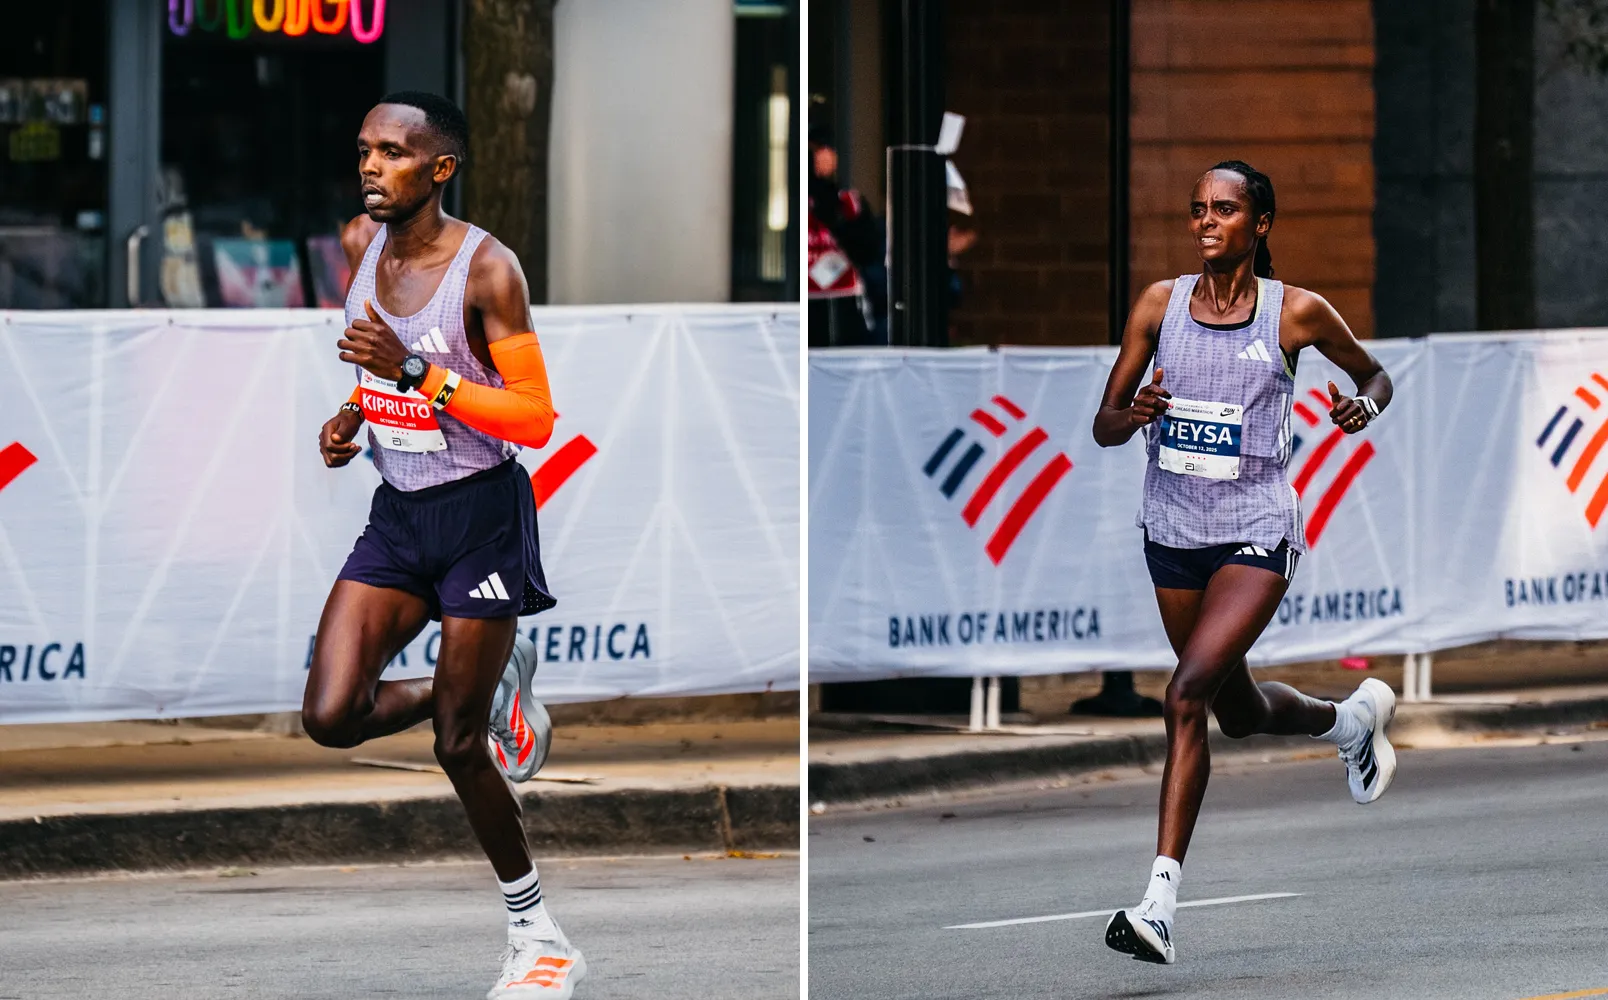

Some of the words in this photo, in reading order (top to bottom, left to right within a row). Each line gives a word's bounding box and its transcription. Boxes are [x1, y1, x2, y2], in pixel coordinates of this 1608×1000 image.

[362, 392, 431, 419] KIPRUTO
[379, 417, 399, 425] OCTOBER
[1177, 443, 1198, 451] OCTOBER
[1278, 595, 1303, 626] OF
[1310, 586, 1403, 624] AMERICA
[1505, 577, 1558, 608] BANK
[1563, 572, 1586, 603] OF
[888, 614, 951, 649] BANK
[957, 611, 989, 645] OF
[994, 597, 1101, 642] AMERICA
[528, 622, 651, 662] ERICA
